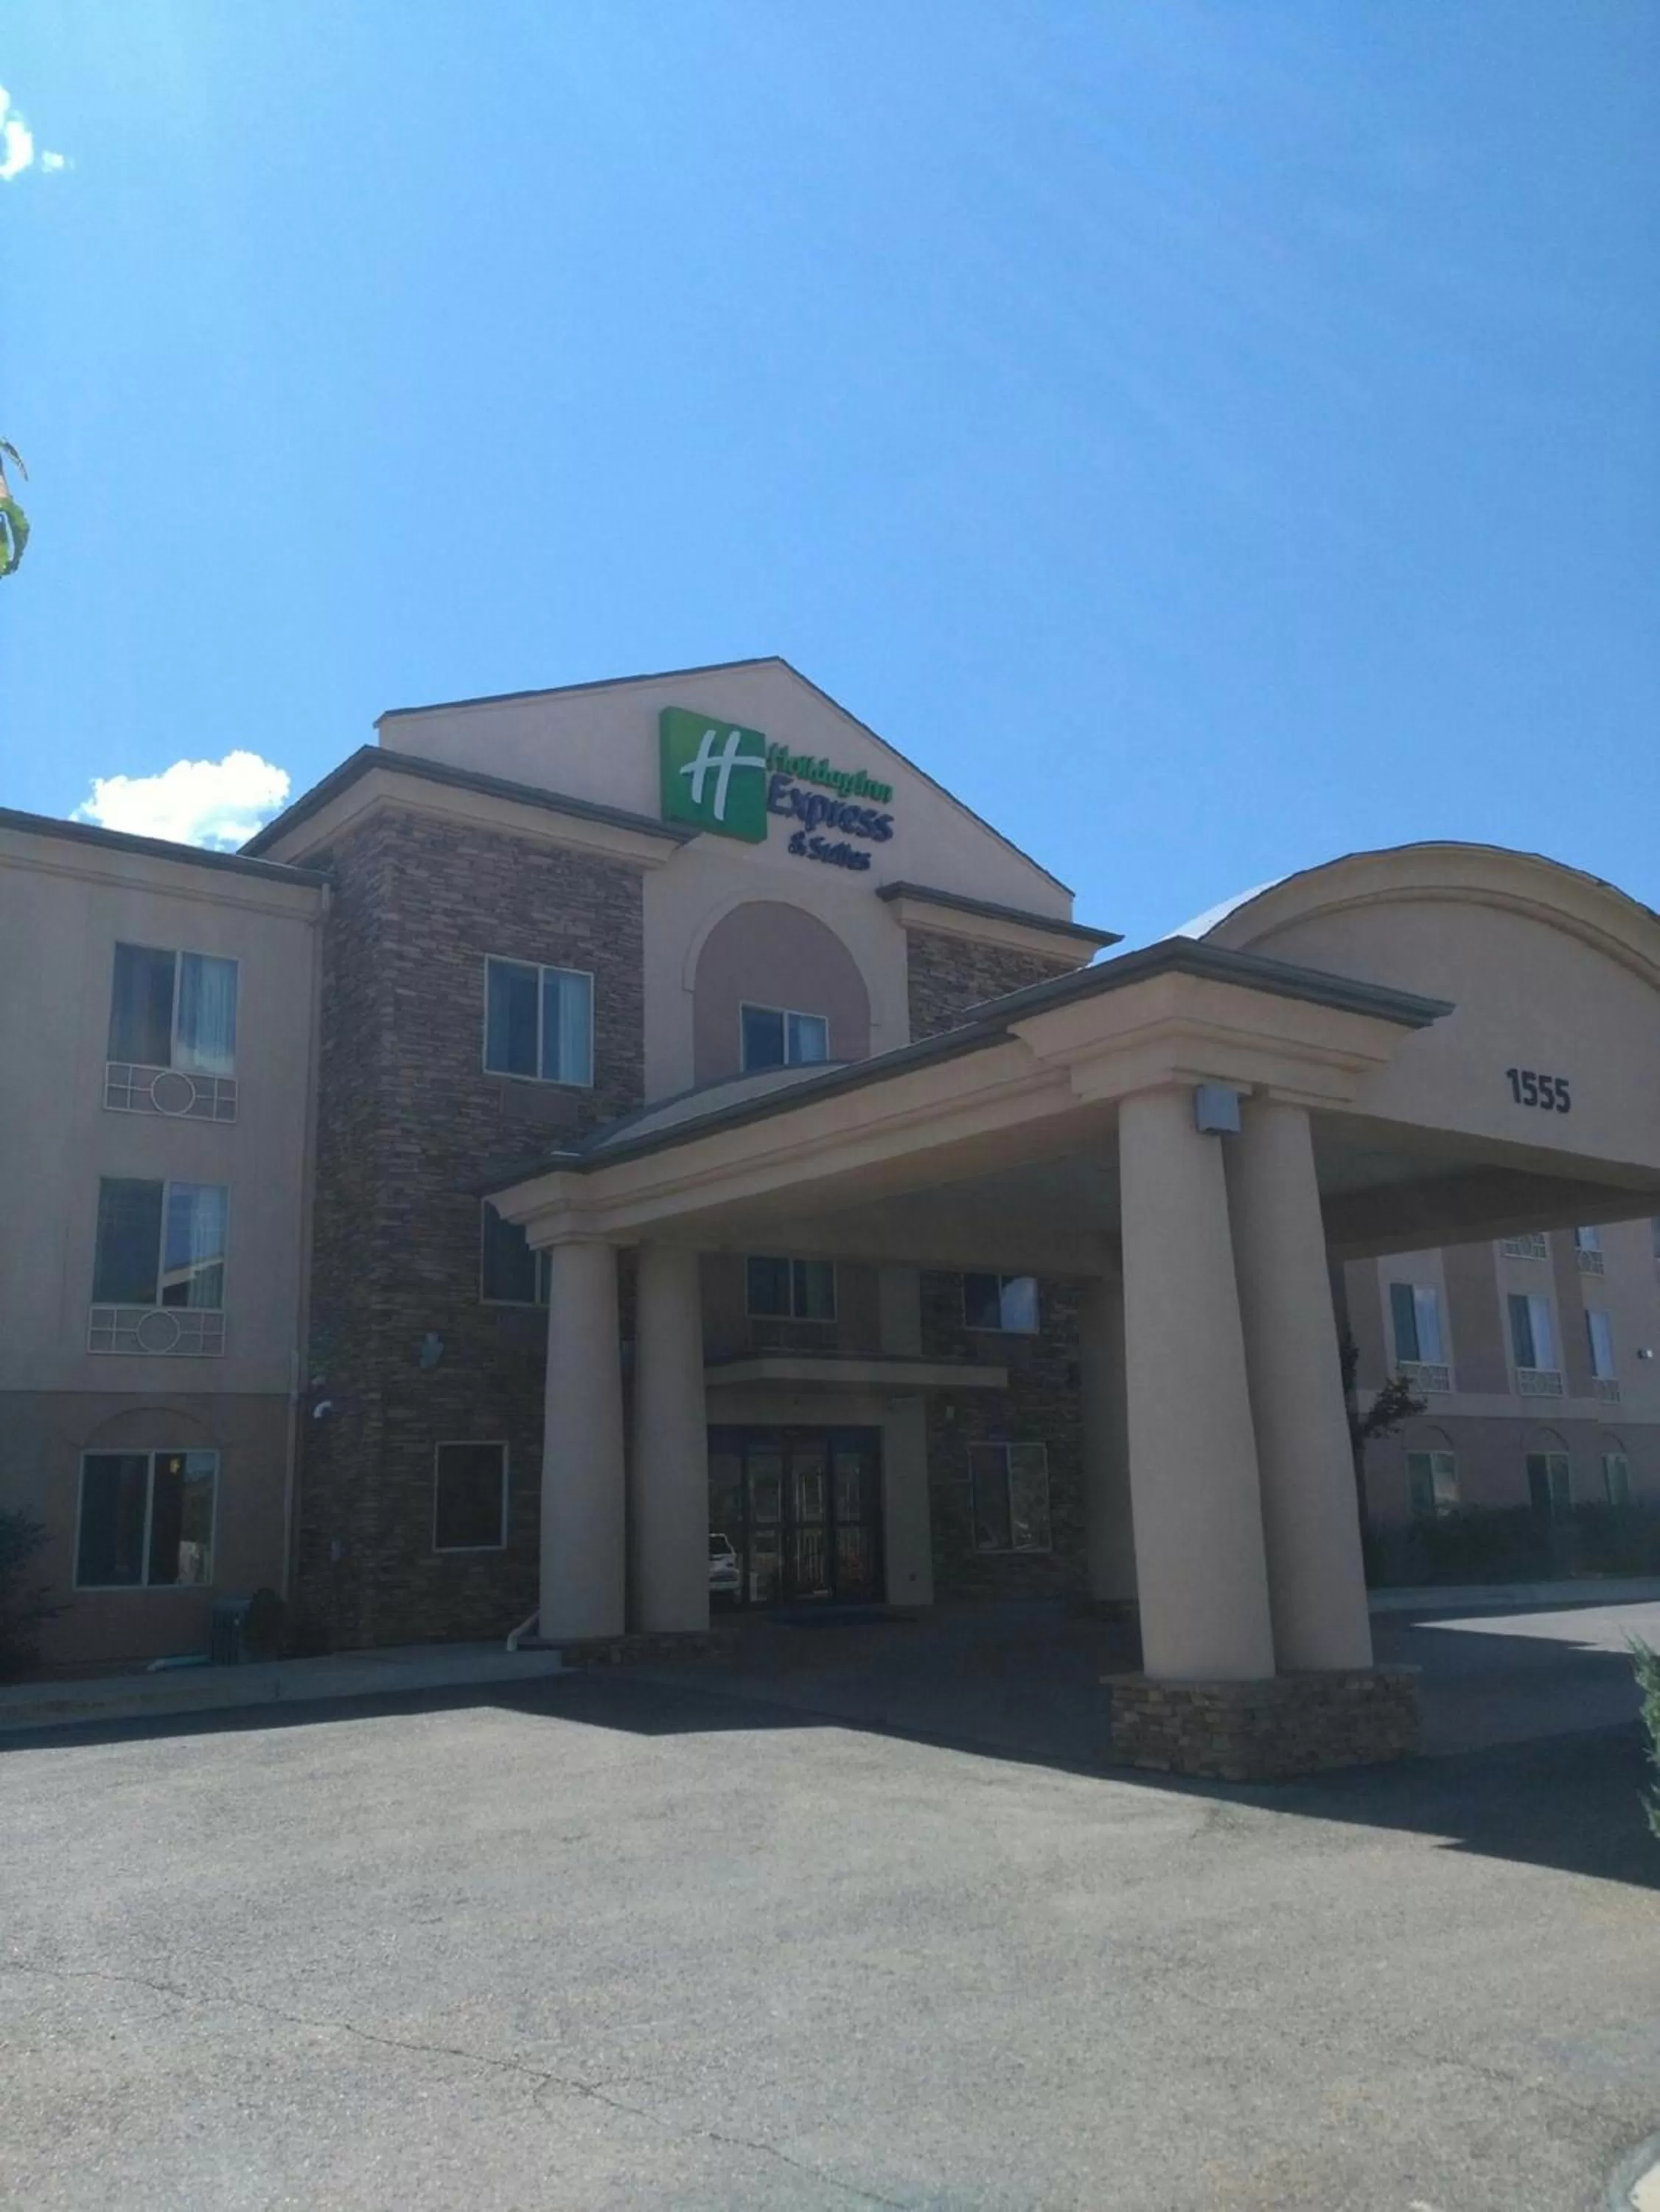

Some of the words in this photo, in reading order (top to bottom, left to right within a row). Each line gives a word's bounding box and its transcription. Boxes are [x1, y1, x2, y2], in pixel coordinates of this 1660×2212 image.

[767, 773, 895, 842] Express
[807, 836, 871, 870] Suites
[1505, 1068, 1571, 1114] 1555
